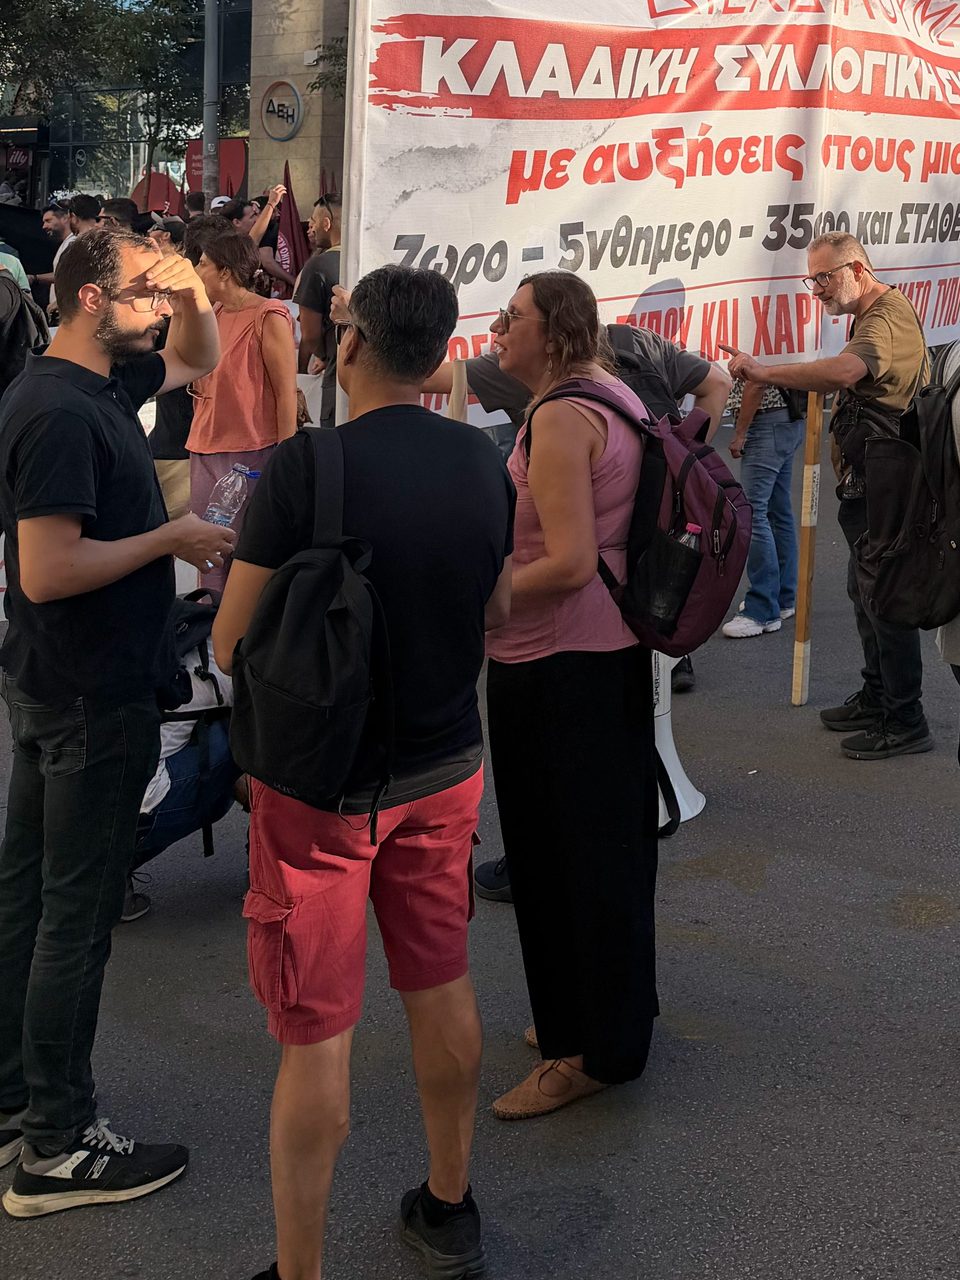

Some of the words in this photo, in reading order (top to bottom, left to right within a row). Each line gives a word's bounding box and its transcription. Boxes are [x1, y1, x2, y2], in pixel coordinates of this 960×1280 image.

[421, 36, 699, 99] ΚΛΑΔΙΚΗ
[713, 43, 943, 102] ΣΥΛΛΟΓΙΚΗ
[266, 98, 295, 123] ΔΕΗ
[9, 150, 28, 166] illy
[506, 148, 571, 205] με
[583, 123, 806, 189] αυξήσεις
[558, 215, 732, 275] 5νθημερο
[857, 210, 894, 245] και
[700, 298, 739, 362] ΚΑΙ
